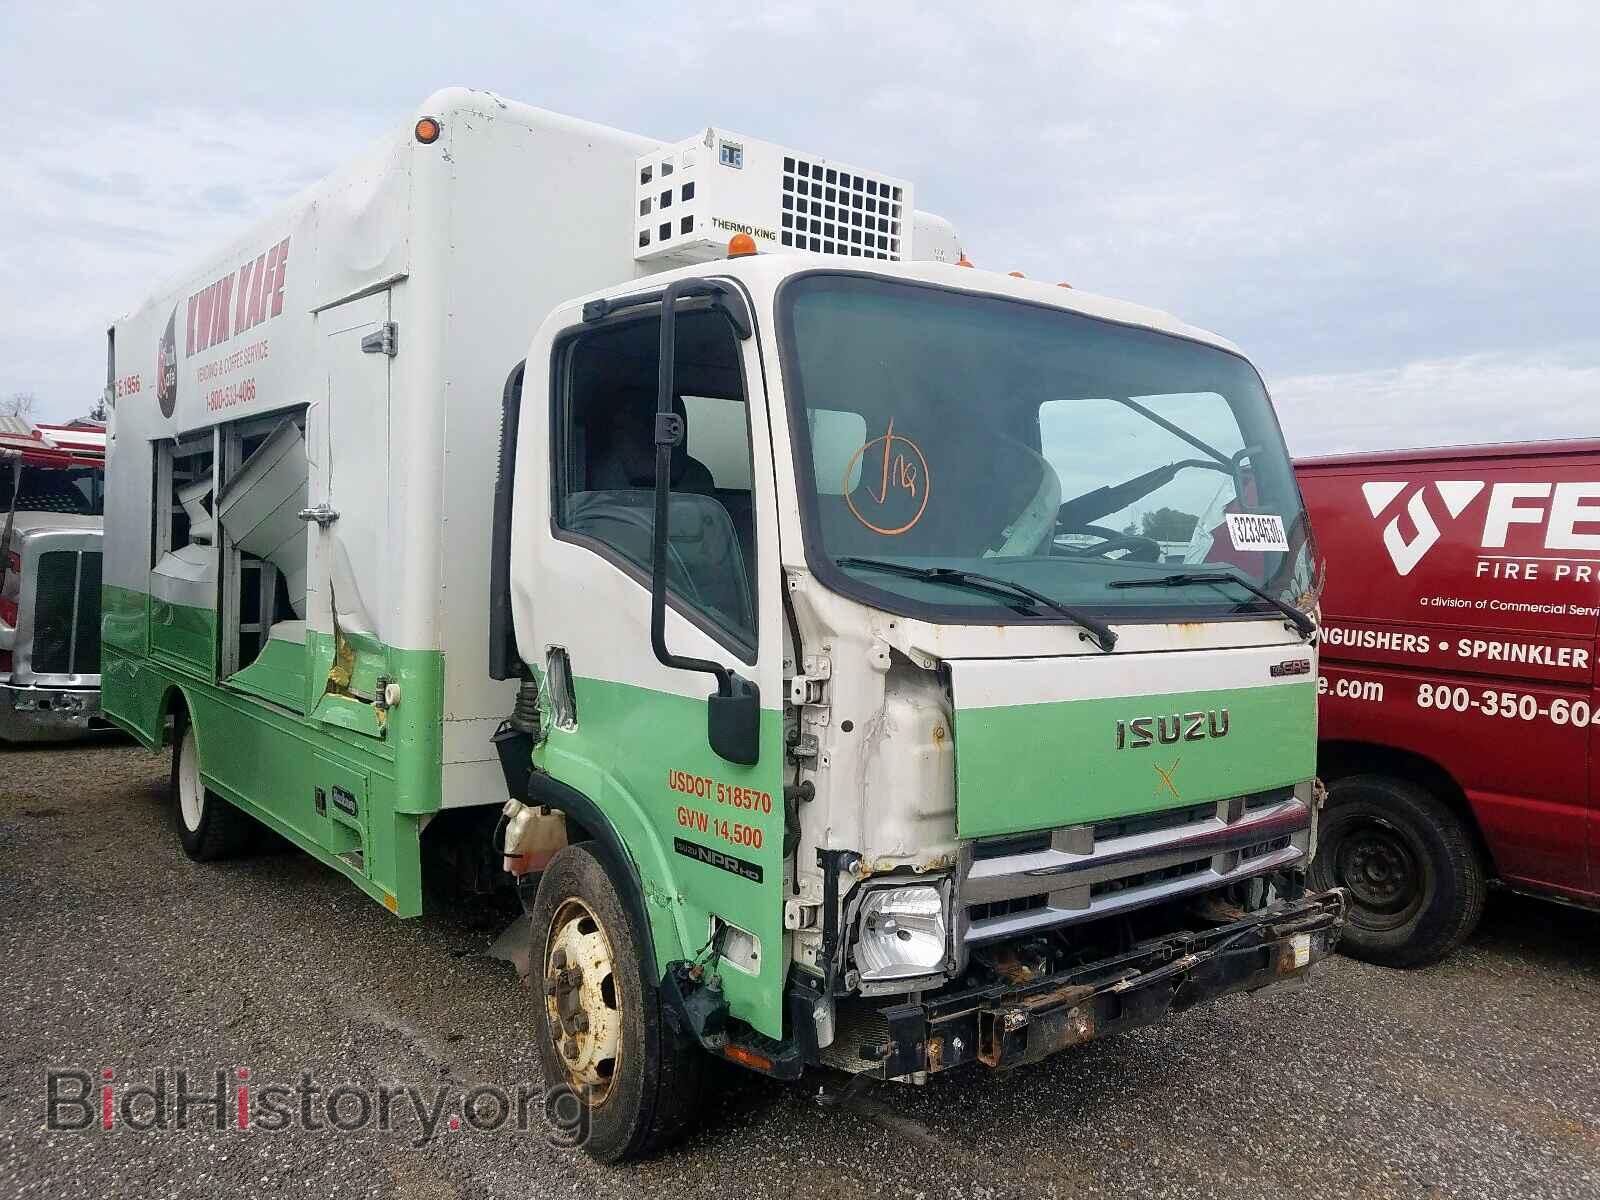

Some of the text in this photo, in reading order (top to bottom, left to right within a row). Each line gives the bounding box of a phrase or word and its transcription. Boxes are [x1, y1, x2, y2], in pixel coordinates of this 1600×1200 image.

[711, 216, 776, 241] THERMO KING
[123, 374, 140, 396] 1956
[1234, 516, 1281, 544] 32334630
[1476, 561, 1600, 582] FIRE PR
[1420, 597, 1428, 606] a
[1431, 596, 1472, 609] division
[1475, 599, 1487, 609] of
[1490, 600, 1566, 615] Commercial
[1457, 638, 1588, 669] SPRINKLER
[1116, 708, 1230, 750] ISUZU
[668, 768, 772, 814] USDOT 518570
[677, 806, 763, 849] GVW 14,500
[698, 847, 738, 872] NPR
[739, 865, 759, 880] HD
